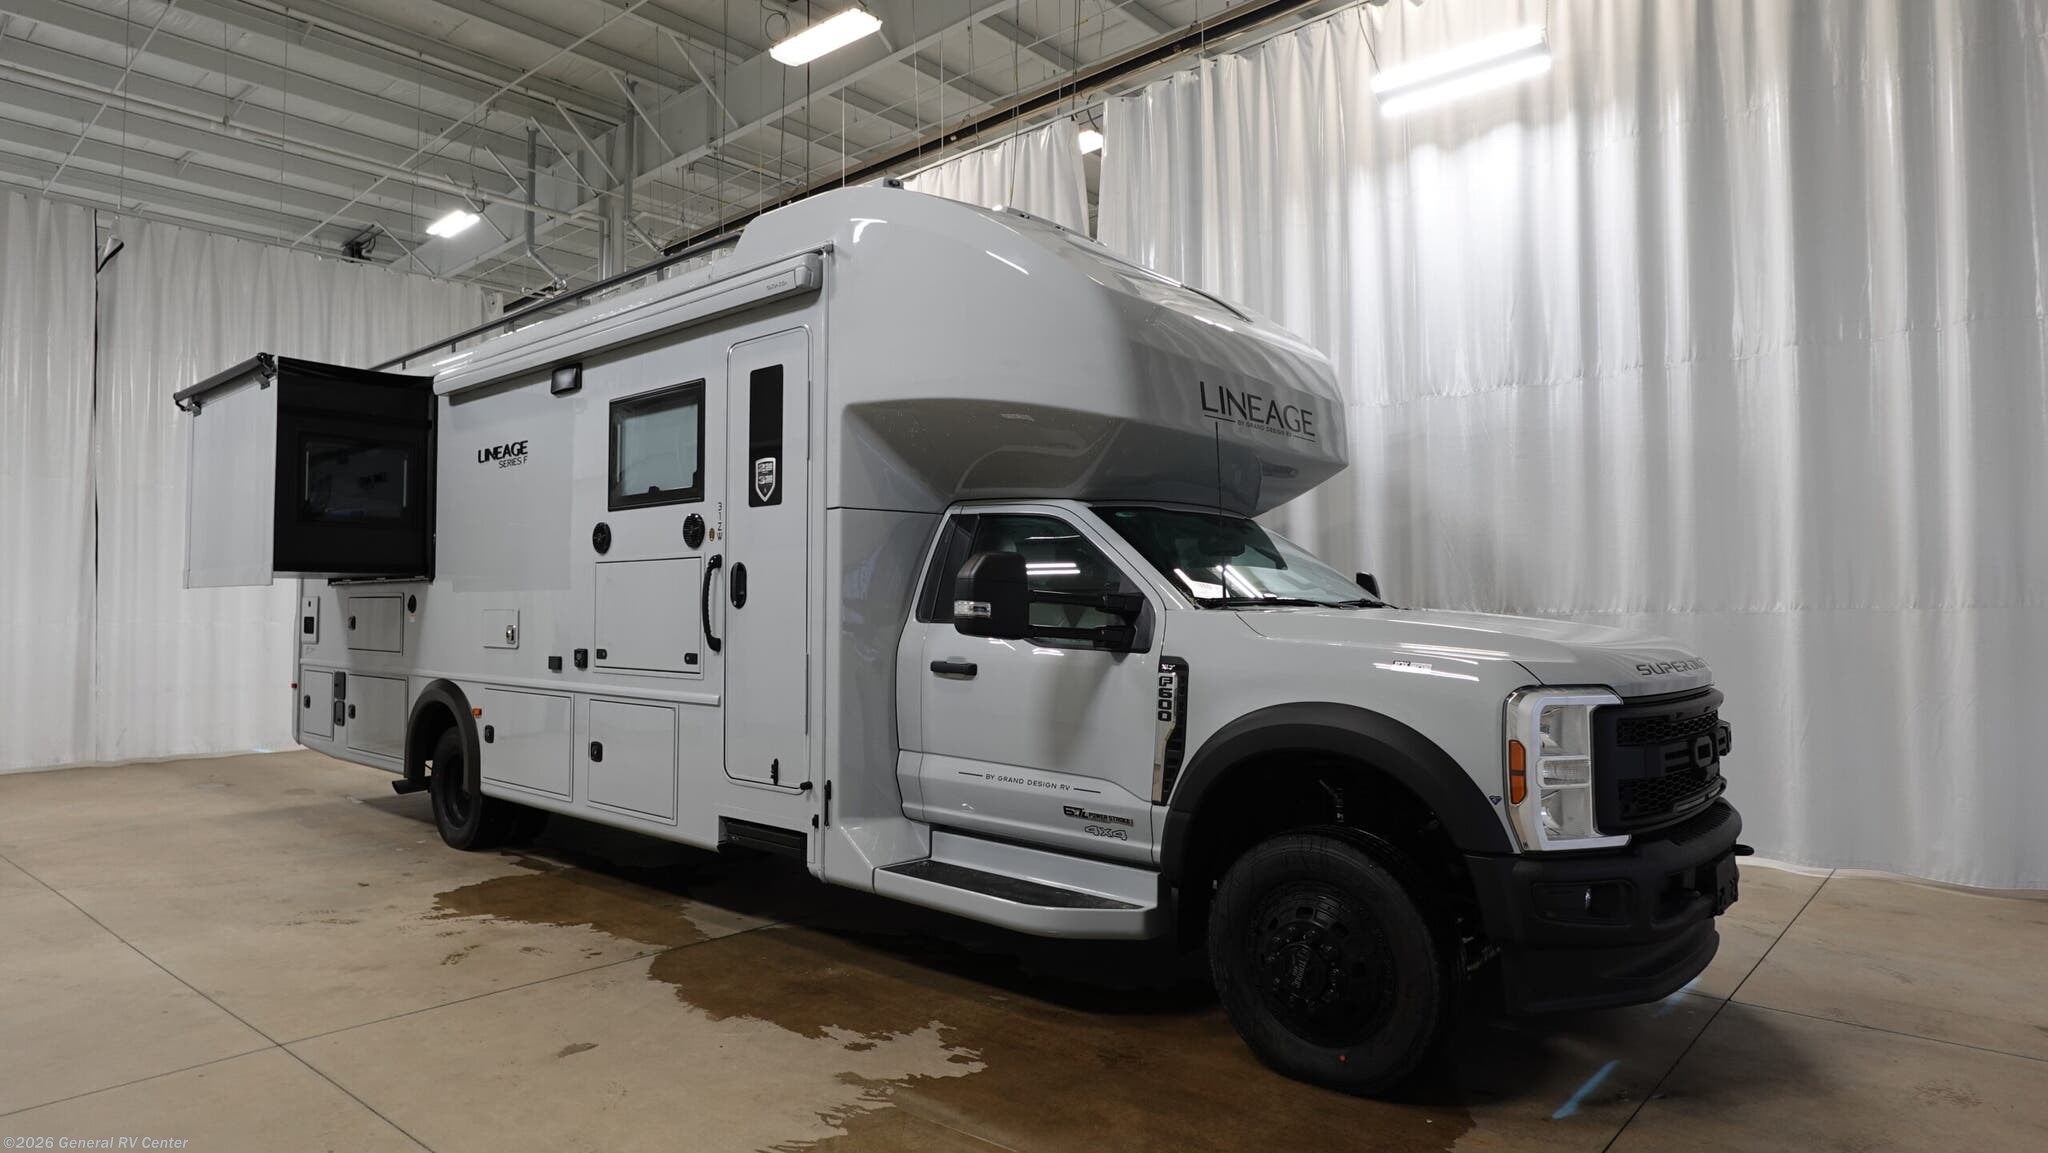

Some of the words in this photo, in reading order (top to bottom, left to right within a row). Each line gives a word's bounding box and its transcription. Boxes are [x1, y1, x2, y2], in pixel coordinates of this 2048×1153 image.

[1199, 380, 1316, 437] LINEAGE
[478, 439, 529, 463] LINEAGE
[499, 456, 522, 469] SERIES
[523, 455, 528, 464] F
[1158, 675, 1174, 722] F600
[997, 775, 1024, 785] GRAND
[1026, 779, 1057, 789] DESIGN
[1060, 784, 1071, 792] RV
